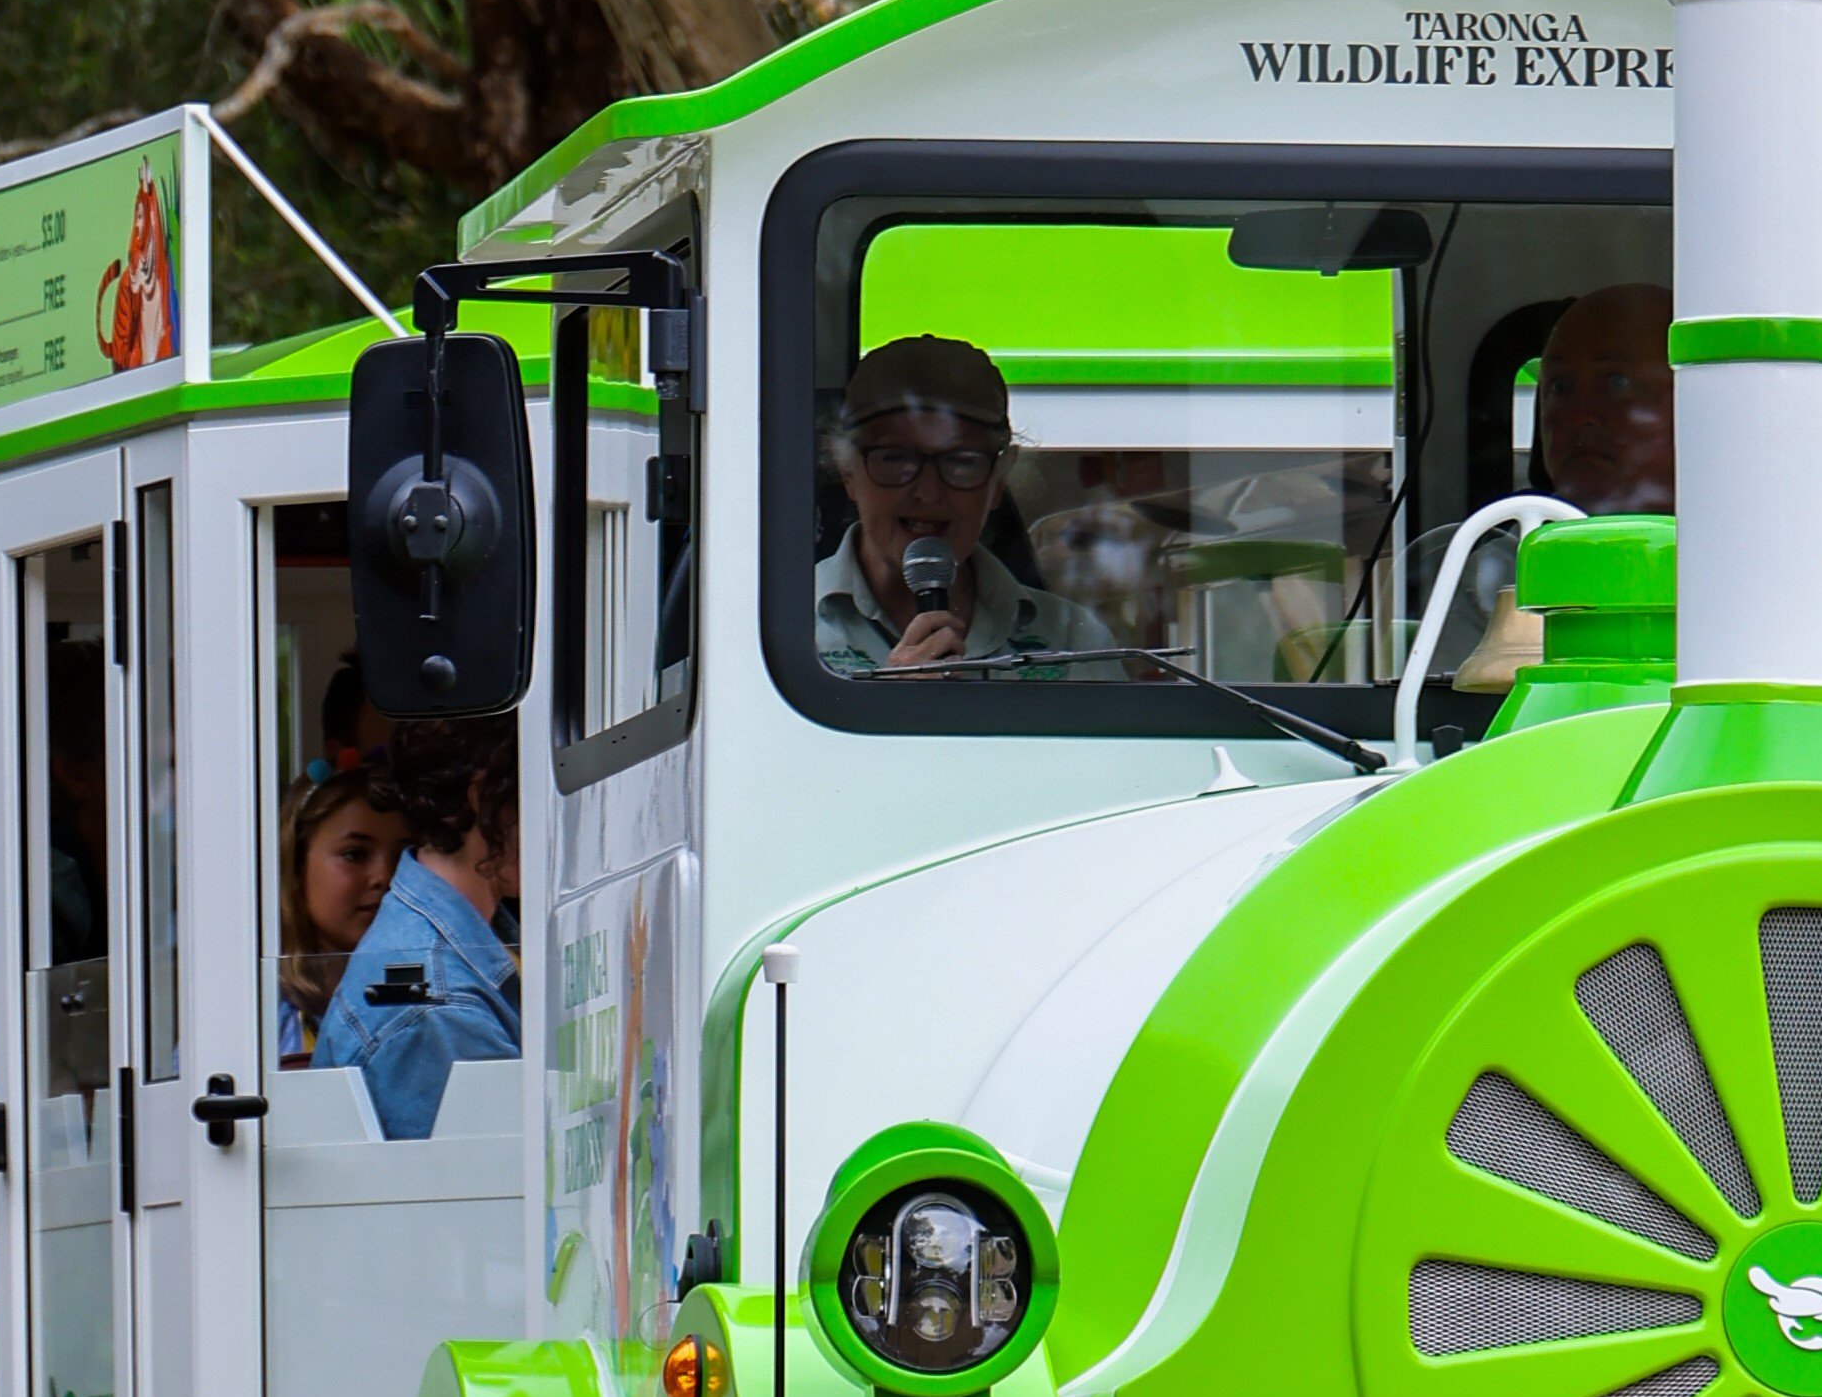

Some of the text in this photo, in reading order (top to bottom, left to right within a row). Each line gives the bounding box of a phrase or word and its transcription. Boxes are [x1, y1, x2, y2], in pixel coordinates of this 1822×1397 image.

[1405, 12, 1589, 42] TARONGA
[1240, 42, 1496, 86] WILDLIFE
[43, 274, 66, 312] FREE
[43, 335, 66, 373] FREE
